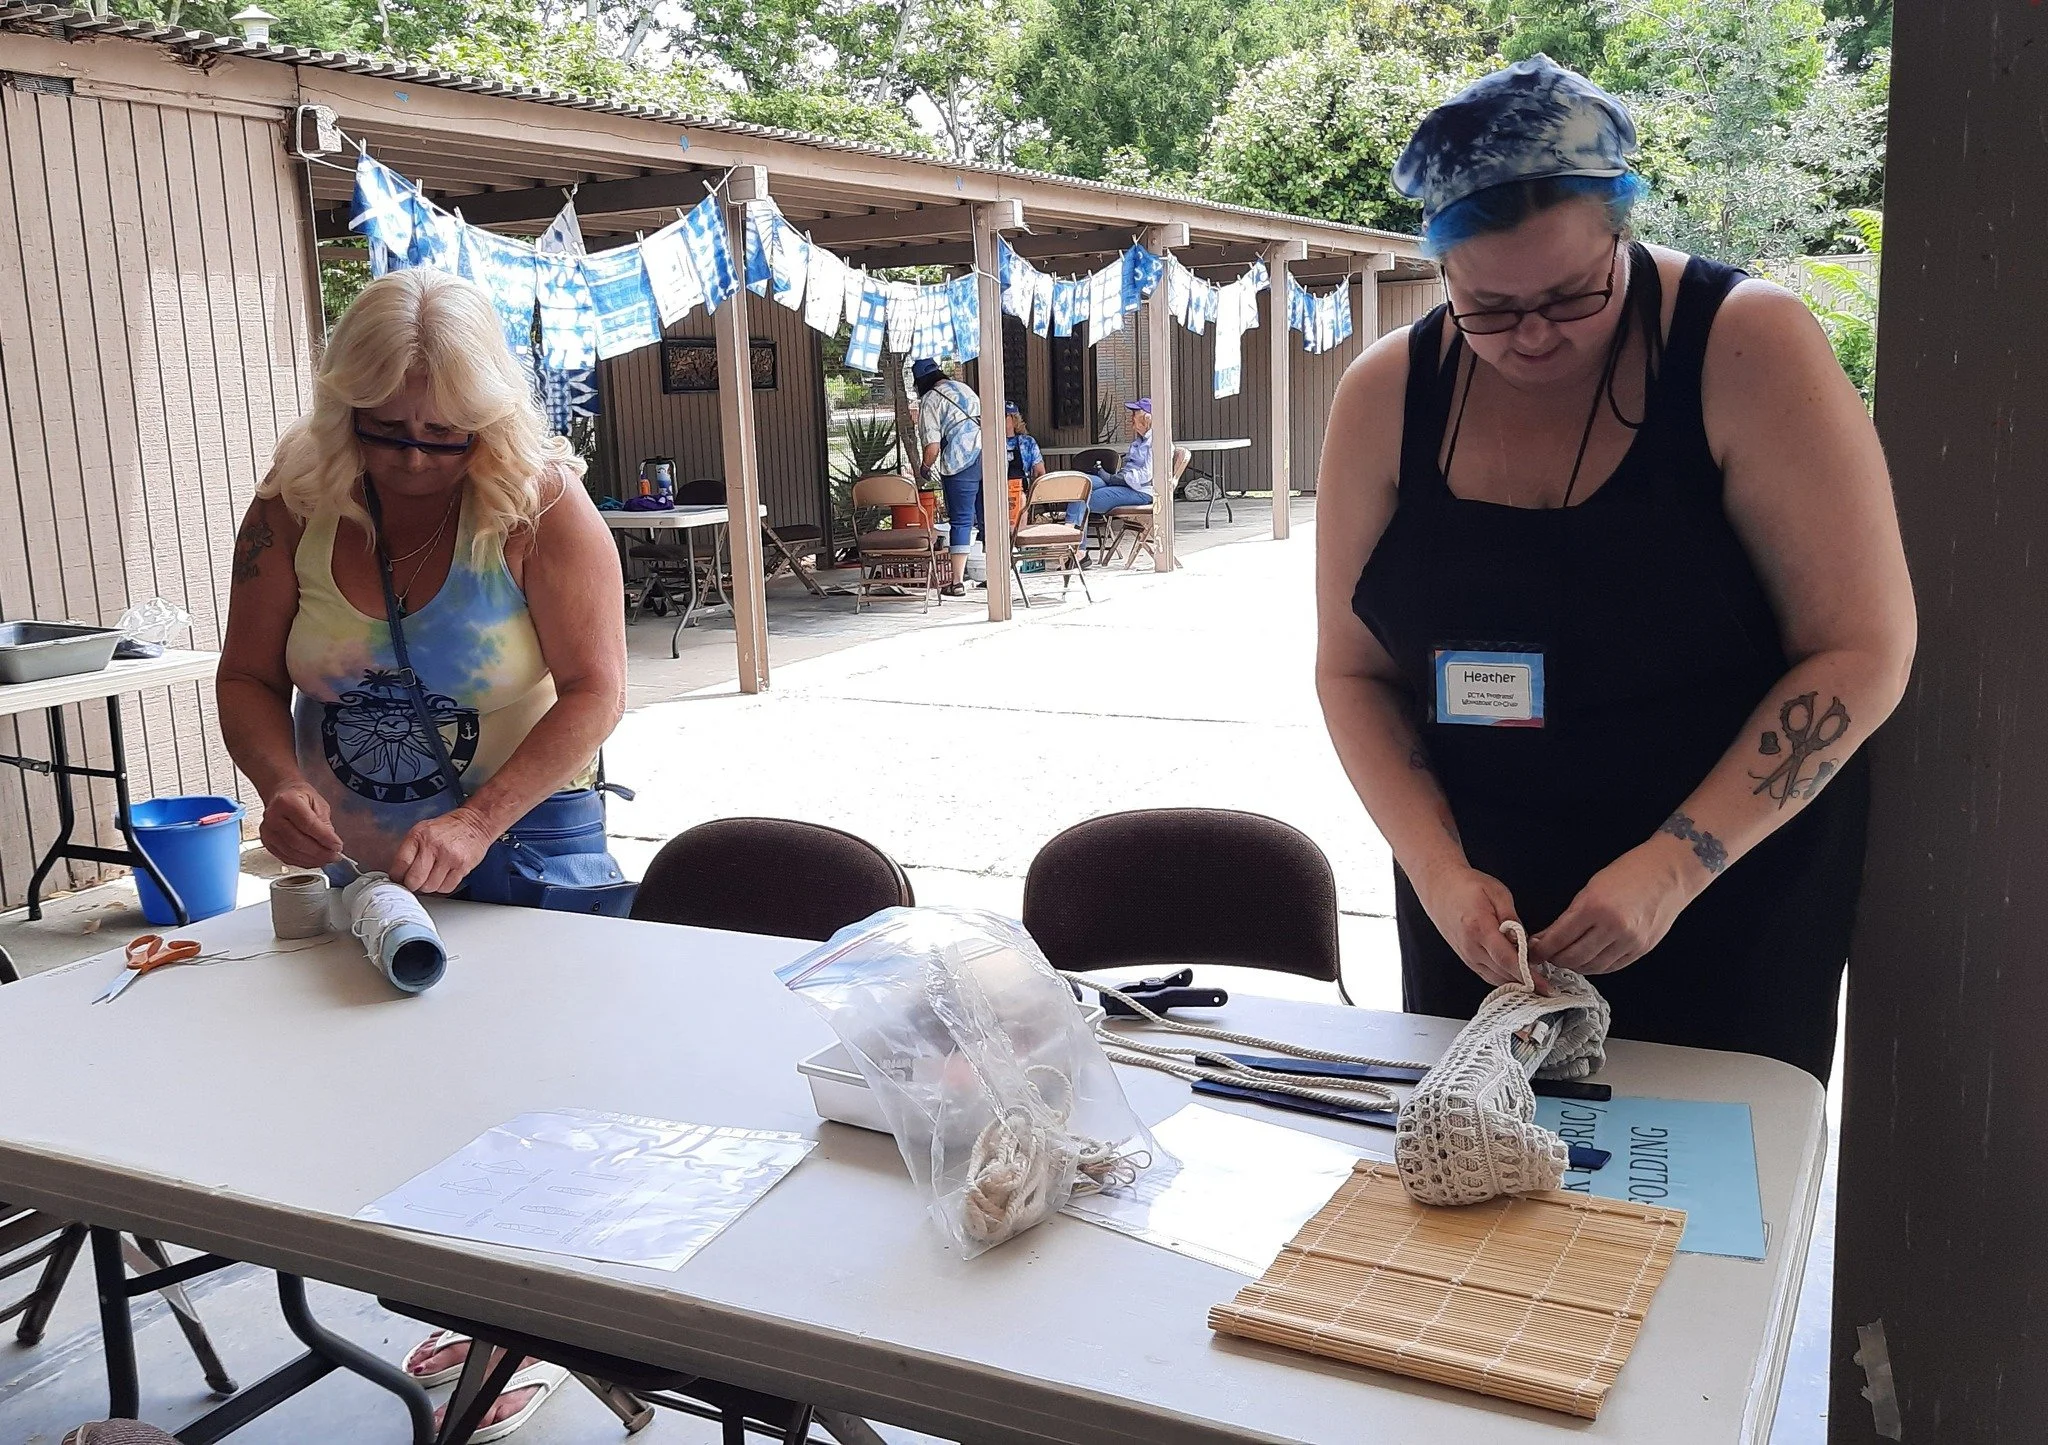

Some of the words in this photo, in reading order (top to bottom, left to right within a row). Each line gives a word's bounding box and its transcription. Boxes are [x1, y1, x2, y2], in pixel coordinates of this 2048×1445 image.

[1464, 671, 1516, 683] Heather
[328, 753, 469, 800] NEVADA
[1559, 1101, 1607, 1174] BRIC/
